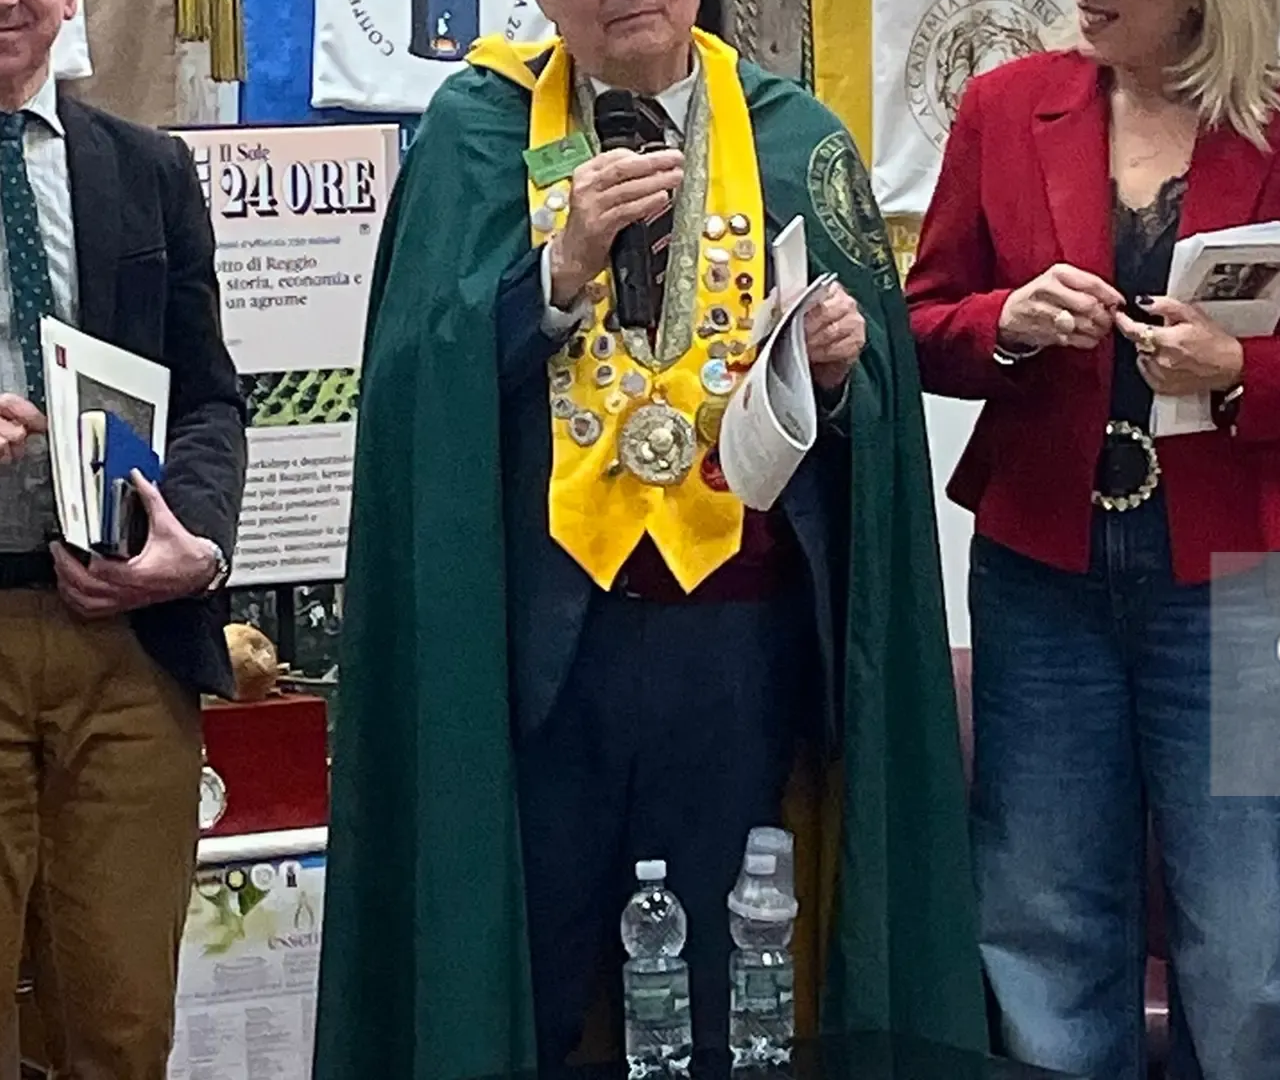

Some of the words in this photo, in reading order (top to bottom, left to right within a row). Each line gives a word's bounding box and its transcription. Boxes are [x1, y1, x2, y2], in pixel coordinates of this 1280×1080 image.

[236, 142, 271, 162] Sole
[219, 161, 279, 219] 24
[282, 159, 377, 216] ORE
[246, 256, 262, 272] di
[266, 254, 318, 273] Reggio
[226, 276, 274, 291] storia,
[278, 271, 350, 288] economia
[353, 273, 363, 285] e
[249, 294, 308, 311] agrume
